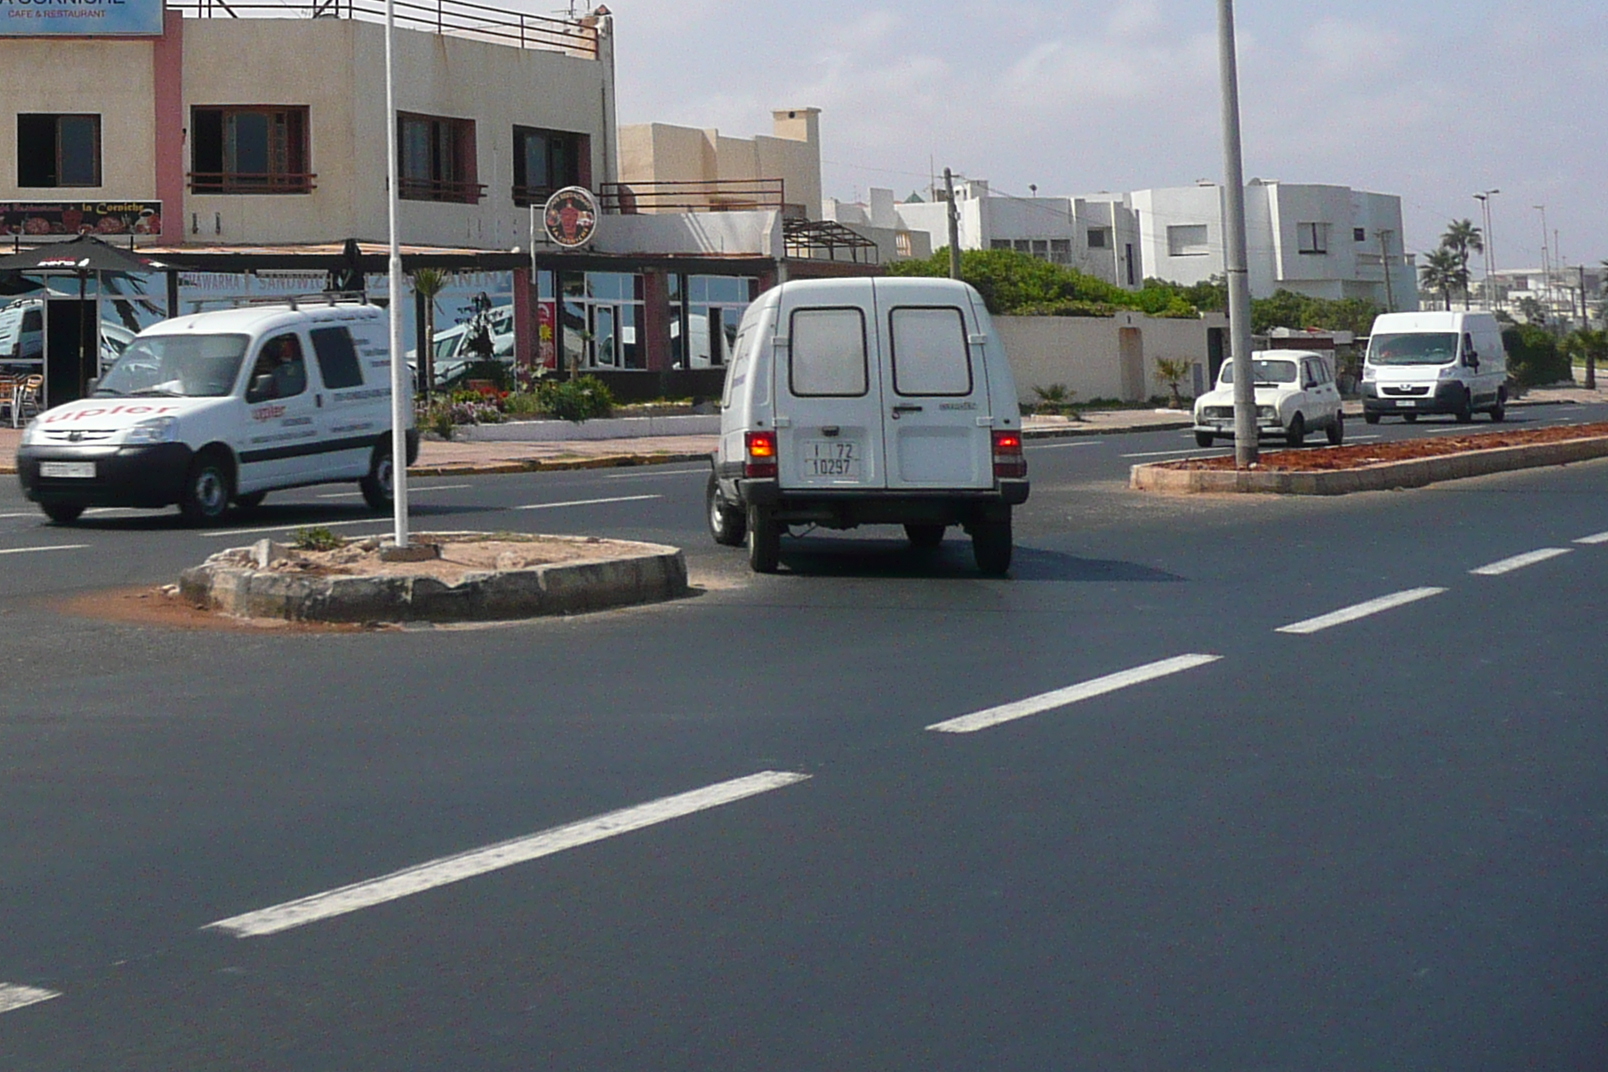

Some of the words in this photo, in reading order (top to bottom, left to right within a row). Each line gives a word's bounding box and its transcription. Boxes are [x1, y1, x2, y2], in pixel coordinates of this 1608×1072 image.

[43, 9, 106, 19] RESTAURANT
[836, 443, 853, 459] 72
[813, 459, 850, 474] 10297
